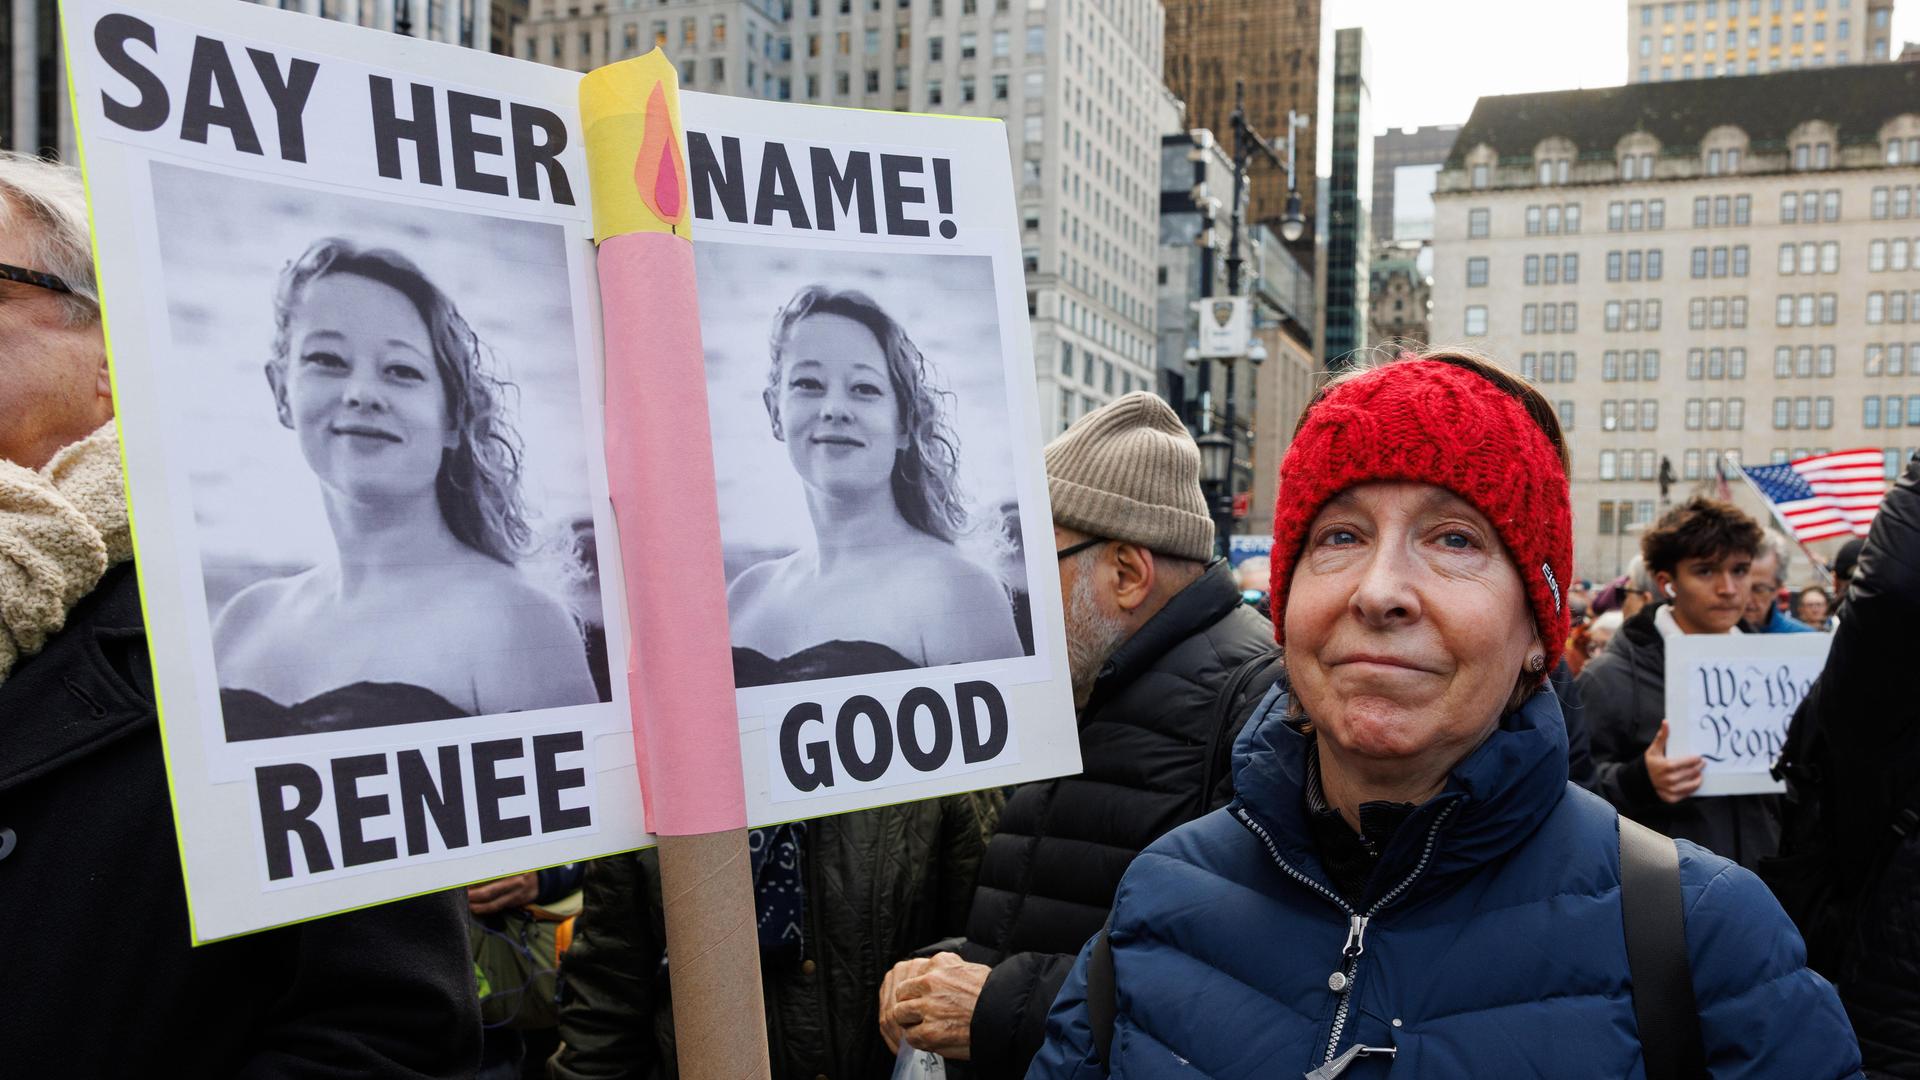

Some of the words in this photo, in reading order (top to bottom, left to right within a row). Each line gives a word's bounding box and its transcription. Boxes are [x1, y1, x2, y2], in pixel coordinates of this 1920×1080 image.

[94, 13, 321, 164] SAY
[368, 74, 576, 207] HER
[687, 130, 958, 240] NAME!
[779, 680, 1009, 793] GOOD
[1698, 664, 1756, 709] We
[254, 730, 592, 882] RENEE
